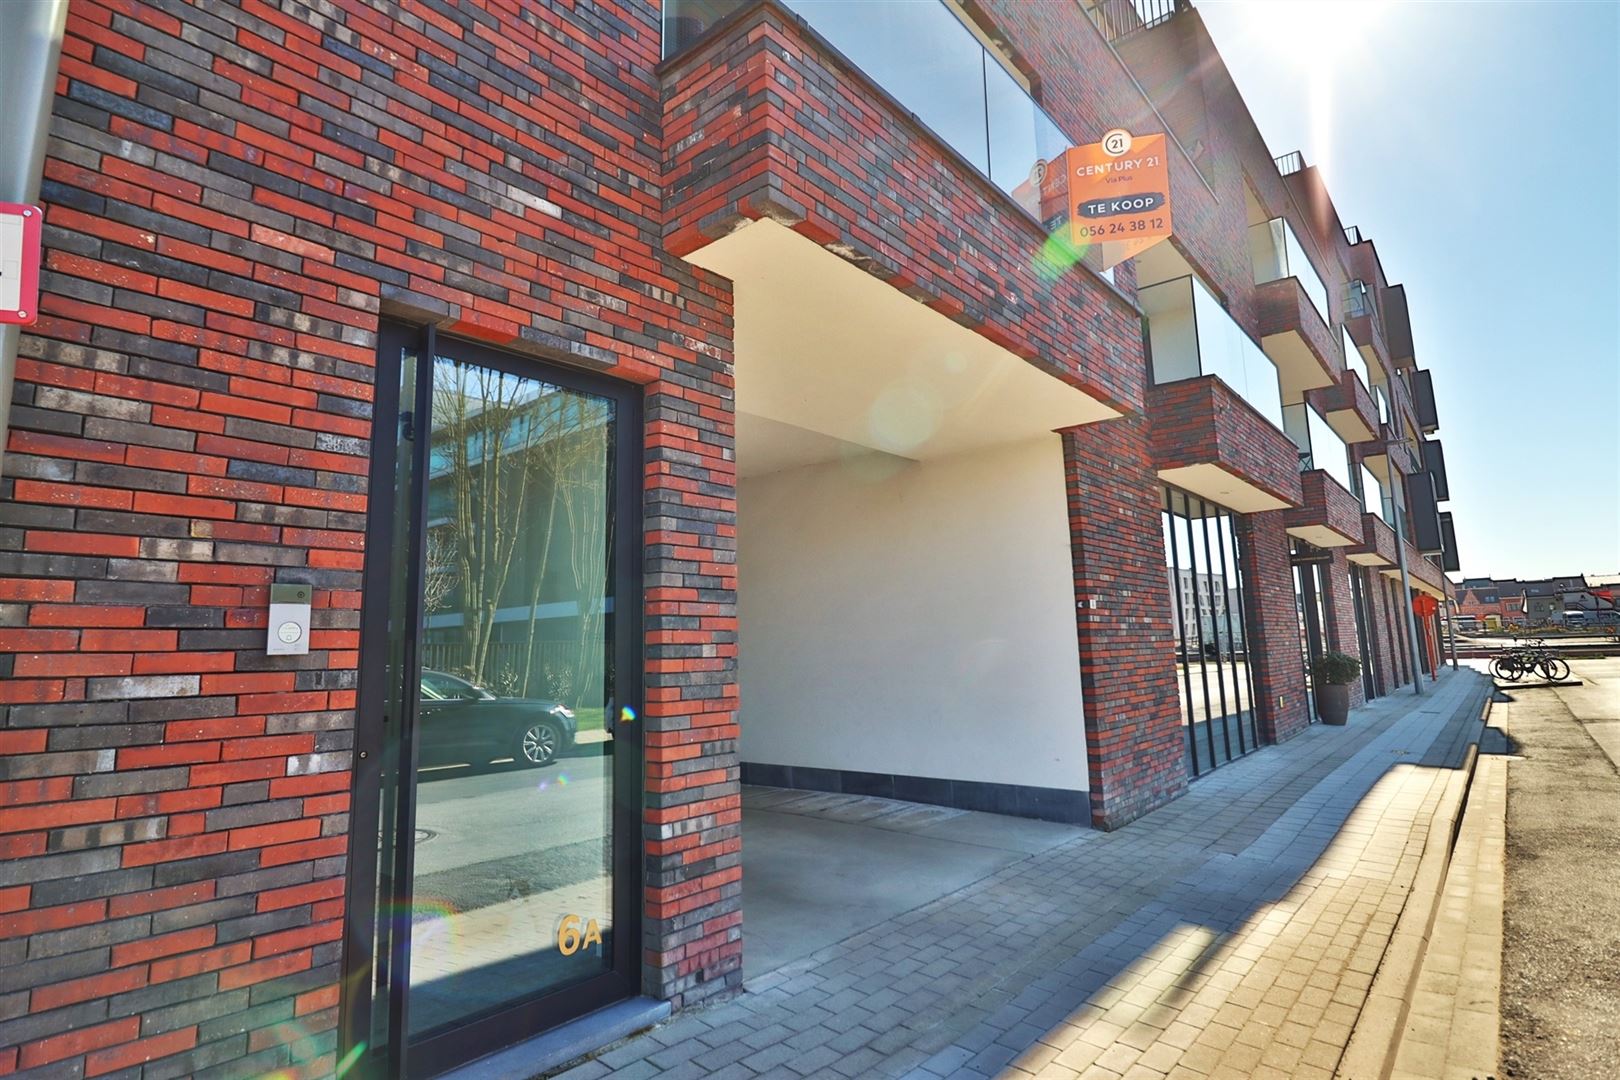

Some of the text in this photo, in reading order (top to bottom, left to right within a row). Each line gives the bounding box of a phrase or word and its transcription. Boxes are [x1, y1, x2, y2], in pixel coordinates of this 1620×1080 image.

[1076, 157, 1159, 176] CENTURY 21
[1105, 176, 1117, 184] Via
[1088, 198, 1154, 214] TE KOOP
[1080, 218, 1163, 237] 056 24 38 12
[558, 914, 602, 956] 6A
